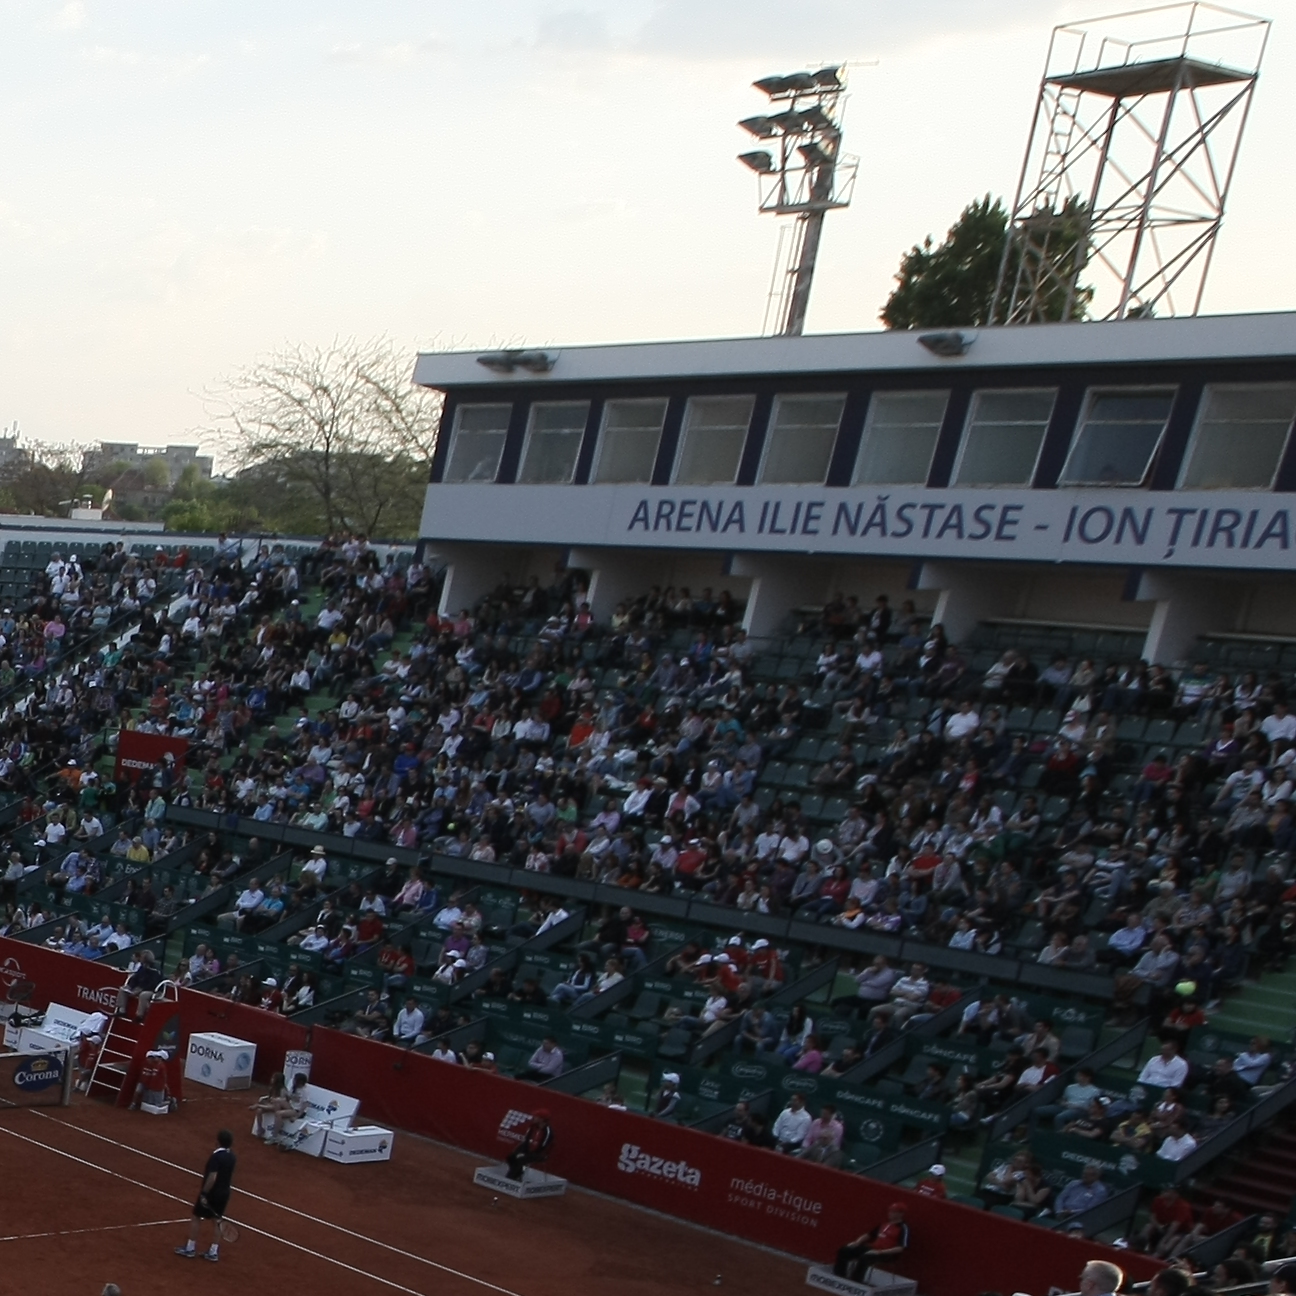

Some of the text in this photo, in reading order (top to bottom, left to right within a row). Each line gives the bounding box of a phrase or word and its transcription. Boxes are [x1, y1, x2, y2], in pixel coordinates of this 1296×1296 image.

[627, 498, 746, 533] ARENA
[757, 500, 825, 536] ILIE
[831, 494, 1024, 542] NĂSTASE
[1062, 505, 1154, 546] ION
[1163, 507, 1296, 560] ȚIRIA
[121, 759, 158, 770] DEDEMA
[76, 984, 118, 1008] TRANSE
[190, 1042, 224, 1064] DORNA
[14, 1070, 58, 1085] Corona
[617, 1142, 702, 1188] gazeta
[477, 1173, 520, 1193] MOBEXPERT
[730, 1177, 823, 1214] média-tique
[727, 1193, 818, 1228] SPORT DIVISION
